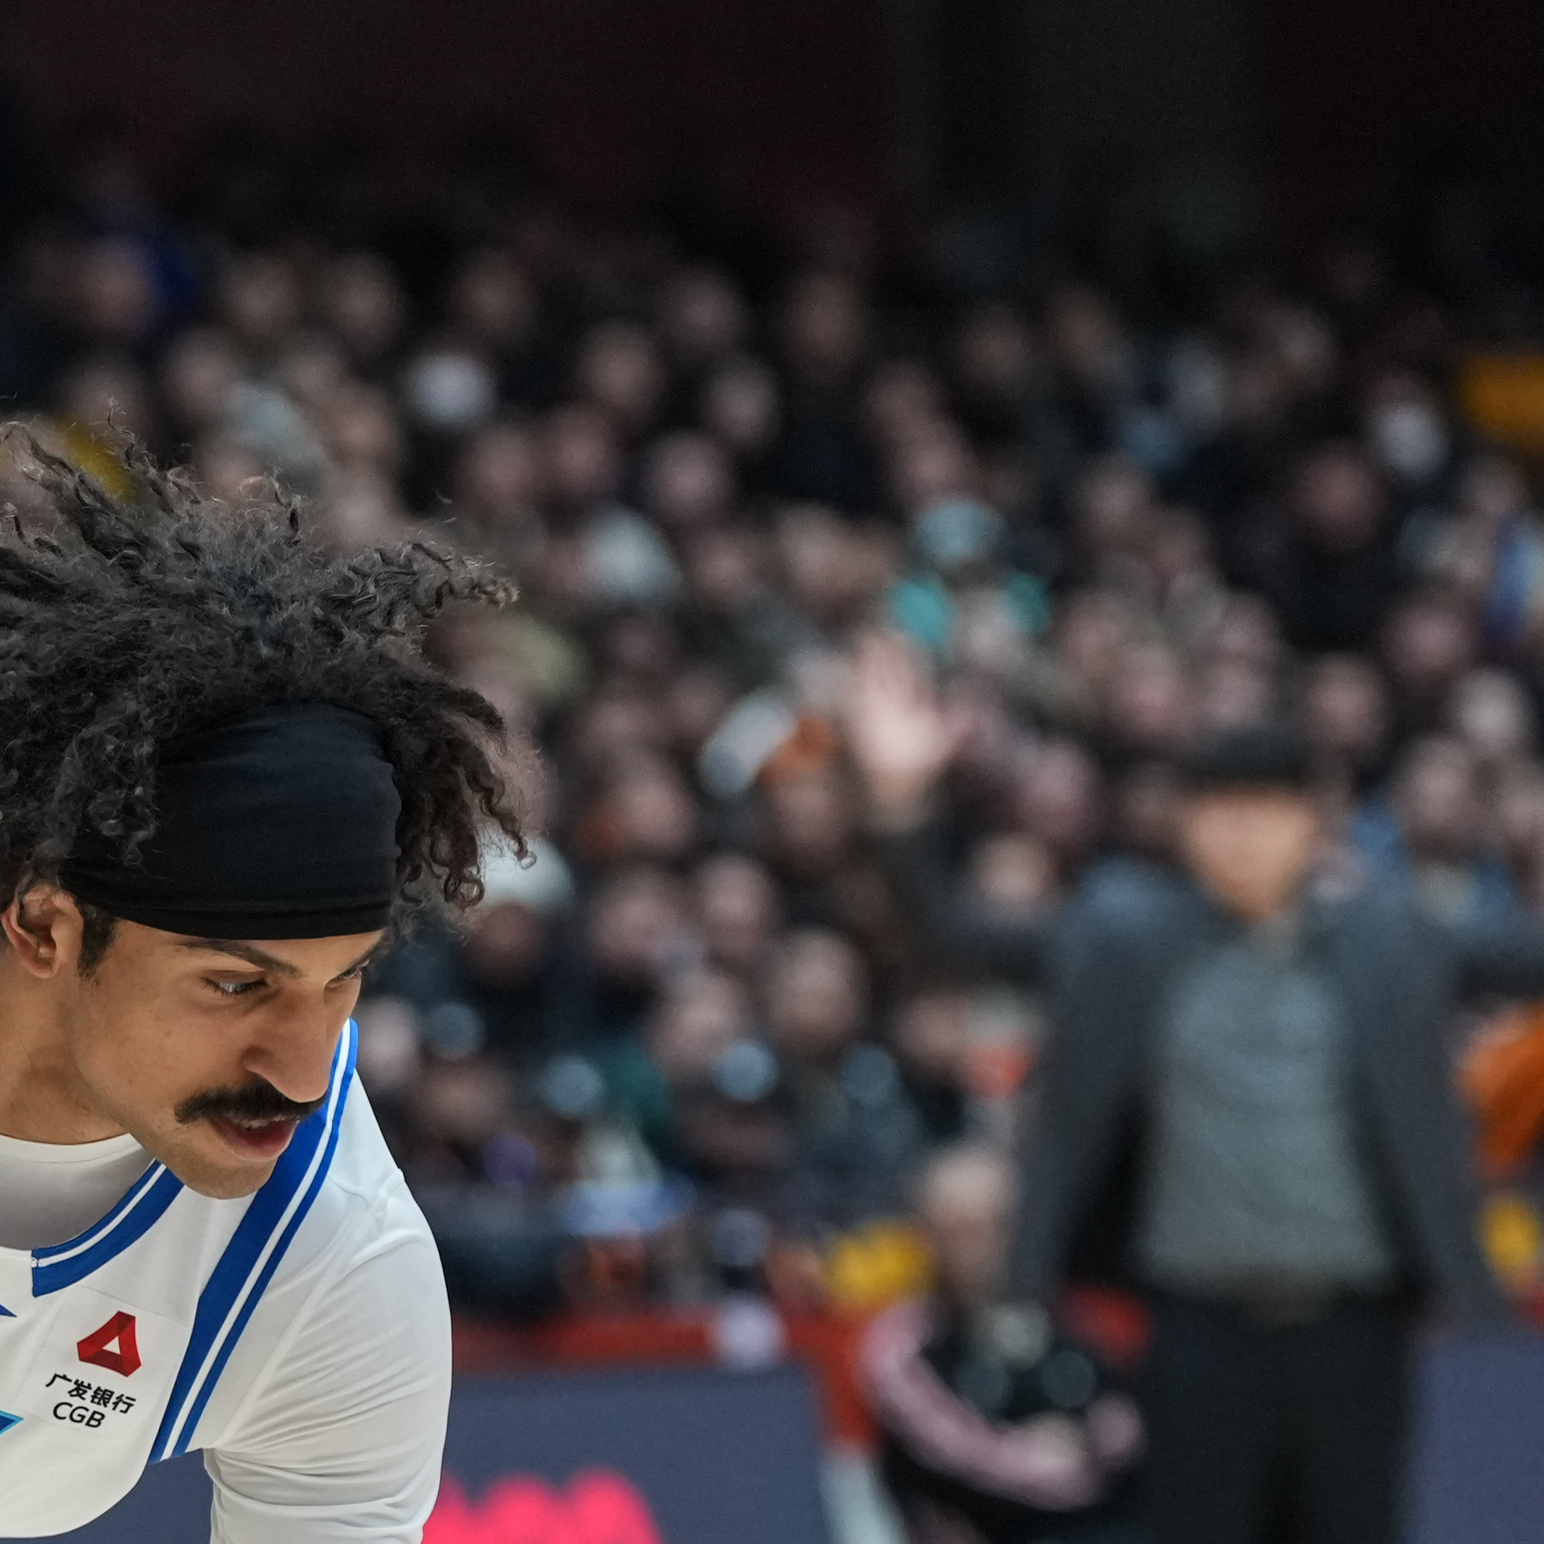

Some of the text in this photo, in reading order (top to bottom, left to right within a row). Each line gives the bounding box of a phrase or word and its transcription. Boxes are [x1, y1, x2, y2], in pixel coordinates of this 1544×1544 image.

[45, 1373, 137, 1415] 广发银行
[52, 1401, 106, 1429] CGB
